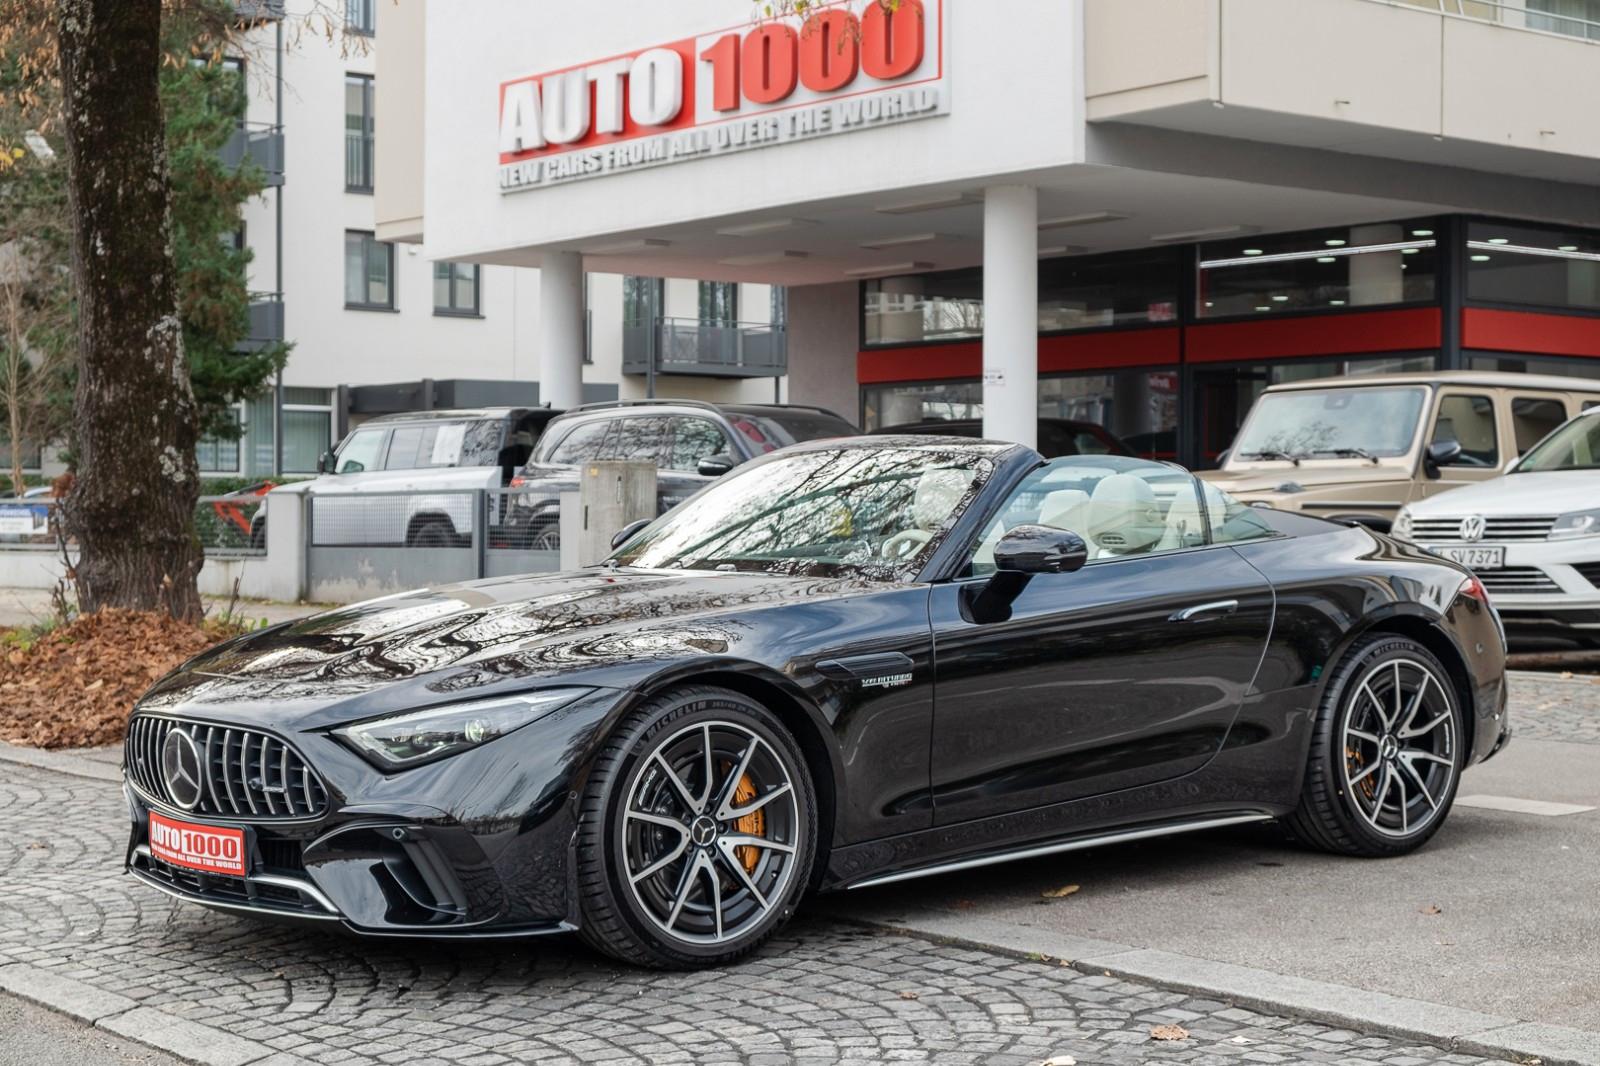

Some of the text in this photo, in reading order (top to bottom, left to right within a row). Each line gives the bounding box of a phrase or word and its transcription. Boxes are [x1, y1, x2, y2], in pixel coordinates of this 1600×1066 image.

[500, 0, 925, 153] AUTO 1000
[499, 86, 938, 188] NEW CARS FROM ALL OVER THE WORLD
[1468, 549, 1500, 564] 7371
[646, 700, 707, 740] MICHELIN
[151, 820, 237, 859] AUTO 1000
[216, 860, 242, 870] WORLD
